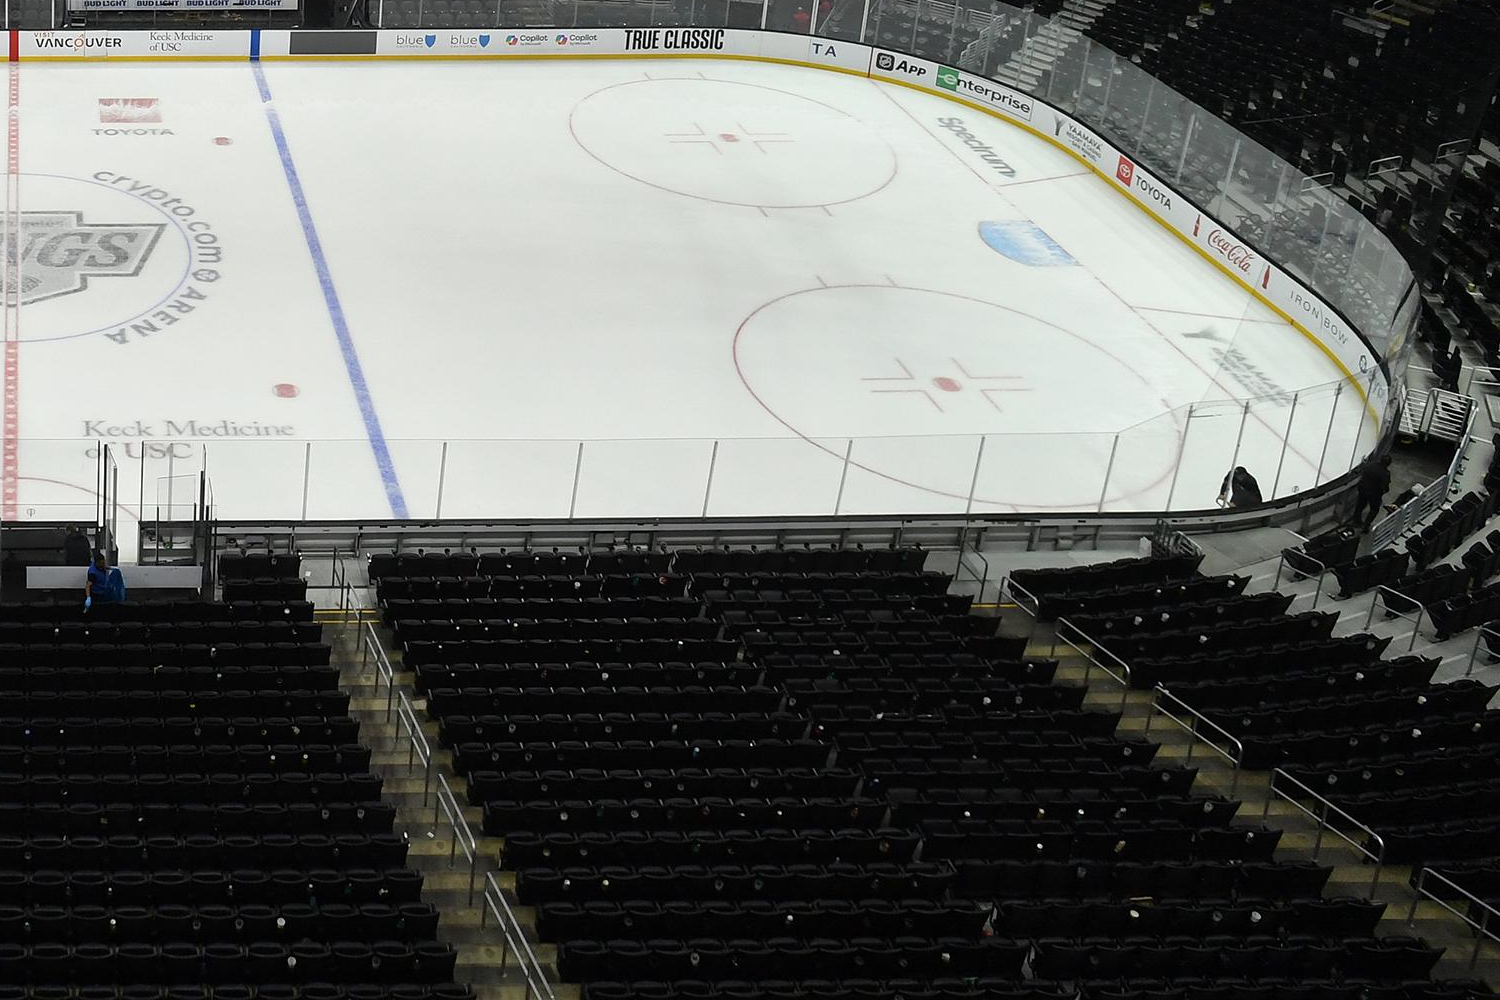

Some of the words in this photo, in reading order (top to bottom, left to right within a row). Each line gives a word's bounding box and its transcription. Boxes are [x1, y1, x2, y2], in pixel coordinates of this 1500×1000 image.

[36, 37, 122, 48] VANCOUVER
[150, 32, 171, 41] Keck
[175, 32, 213, 41] Medicine
[396, 35, 423, 45] blue
[451, 35, 477, 45] blue
[520, 34, 548, 44] Copilot
[570, 34, 597, 44] Copilot
[625, 30, 660, 50] TRUE
[664, 30, 724, 50] CLASSIC
[150, 42, 159, 52] of
[161, 43, 181, 52] USC
[939, 72, 1030, 114] enterprise
[93, 128, 174, 136] TOYOTA
[938, 116, 1017, 178] Spectrum
[1135, 175, 1172, 210] TOYOTA
[93, 171, 223, 265] crypto.com
[104, 286, 208, 344] ARENA
[1290, 291, 1319, 319] IRON
[1323, 318, 1348, 345] BOW
[83, 419, 158, 438] Keck
[165, 419, 294, 437] Medicine
[126, 443, 194, 459] USC
